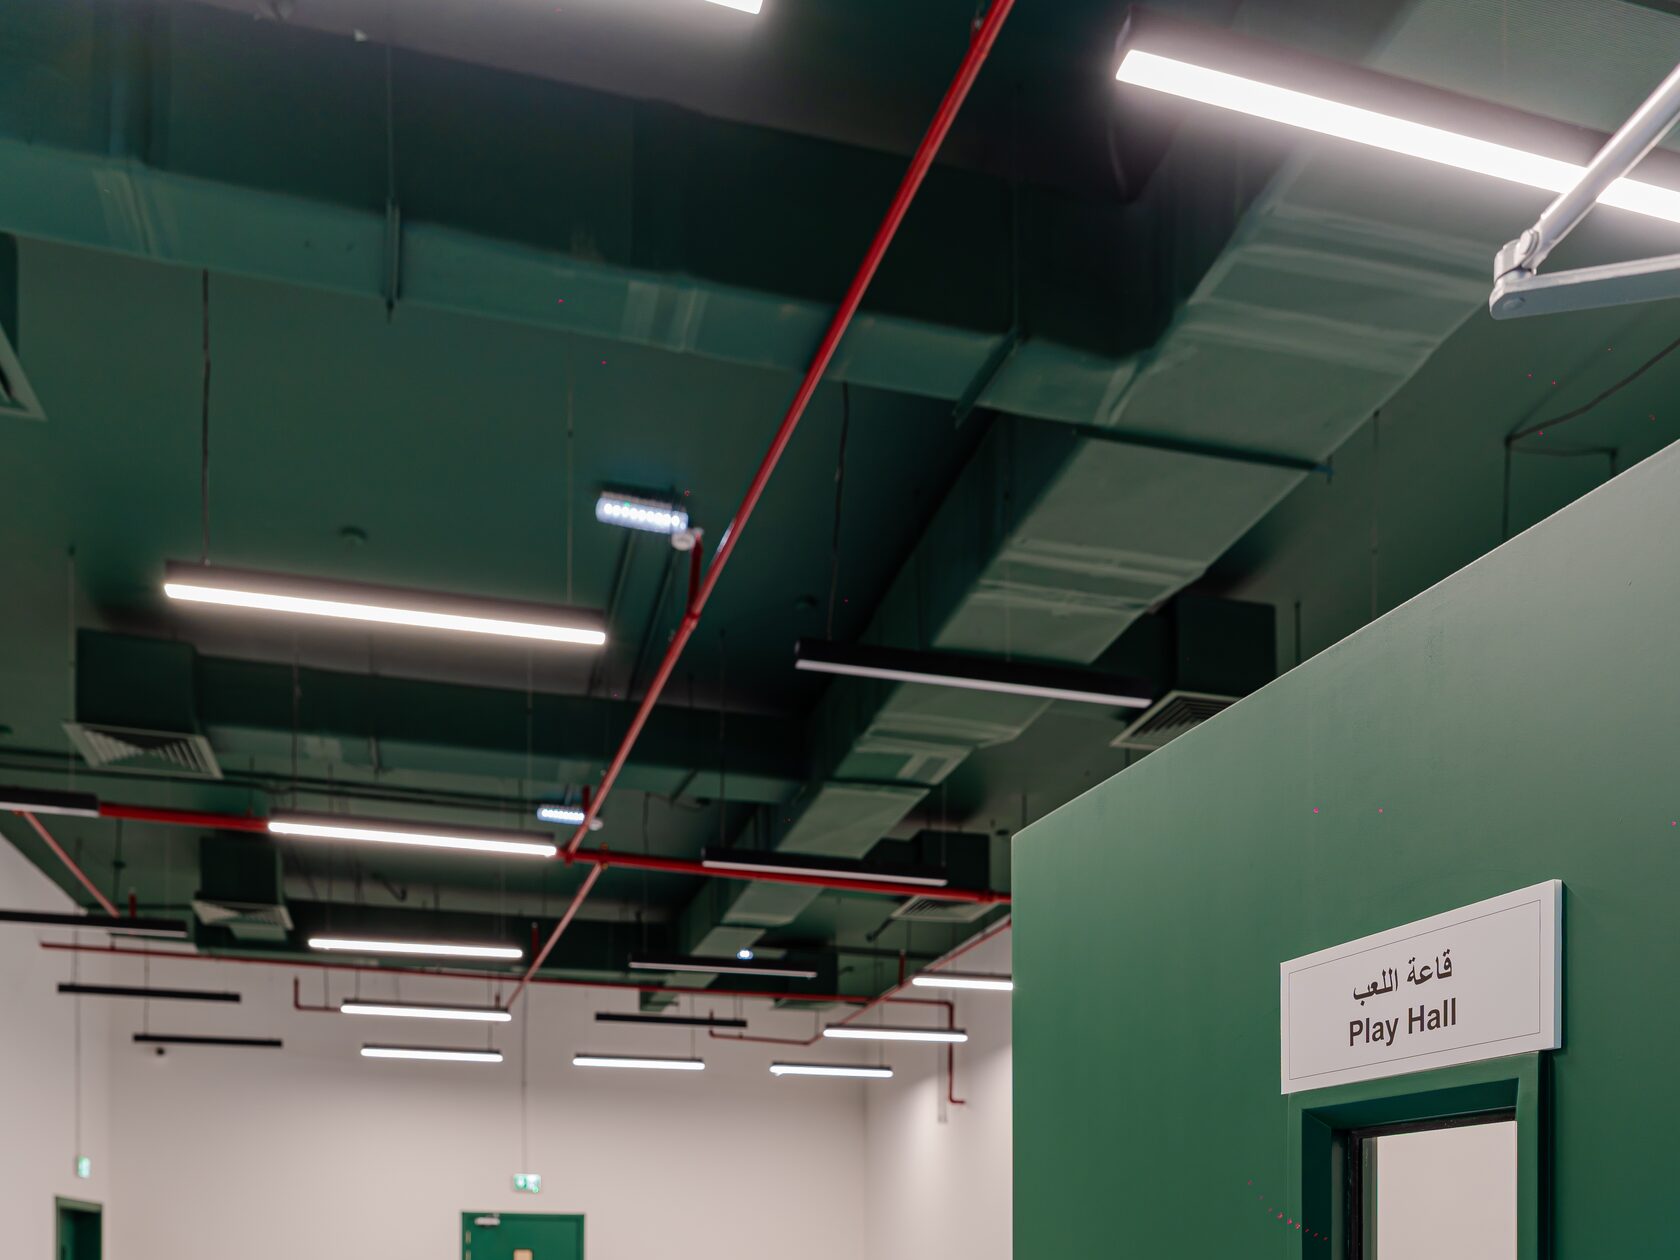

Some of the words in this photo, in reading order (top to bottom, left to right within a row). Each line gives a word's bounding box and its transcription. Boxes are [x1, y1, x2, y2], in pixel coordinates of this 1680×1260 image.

[1352, 967, 1399, 1007] اللعب
[1406, 948, 1453, 986] قاعة
[1349, 1017, 1400, 1047] Play
[1408, 997, 1457, 1035] Hall
